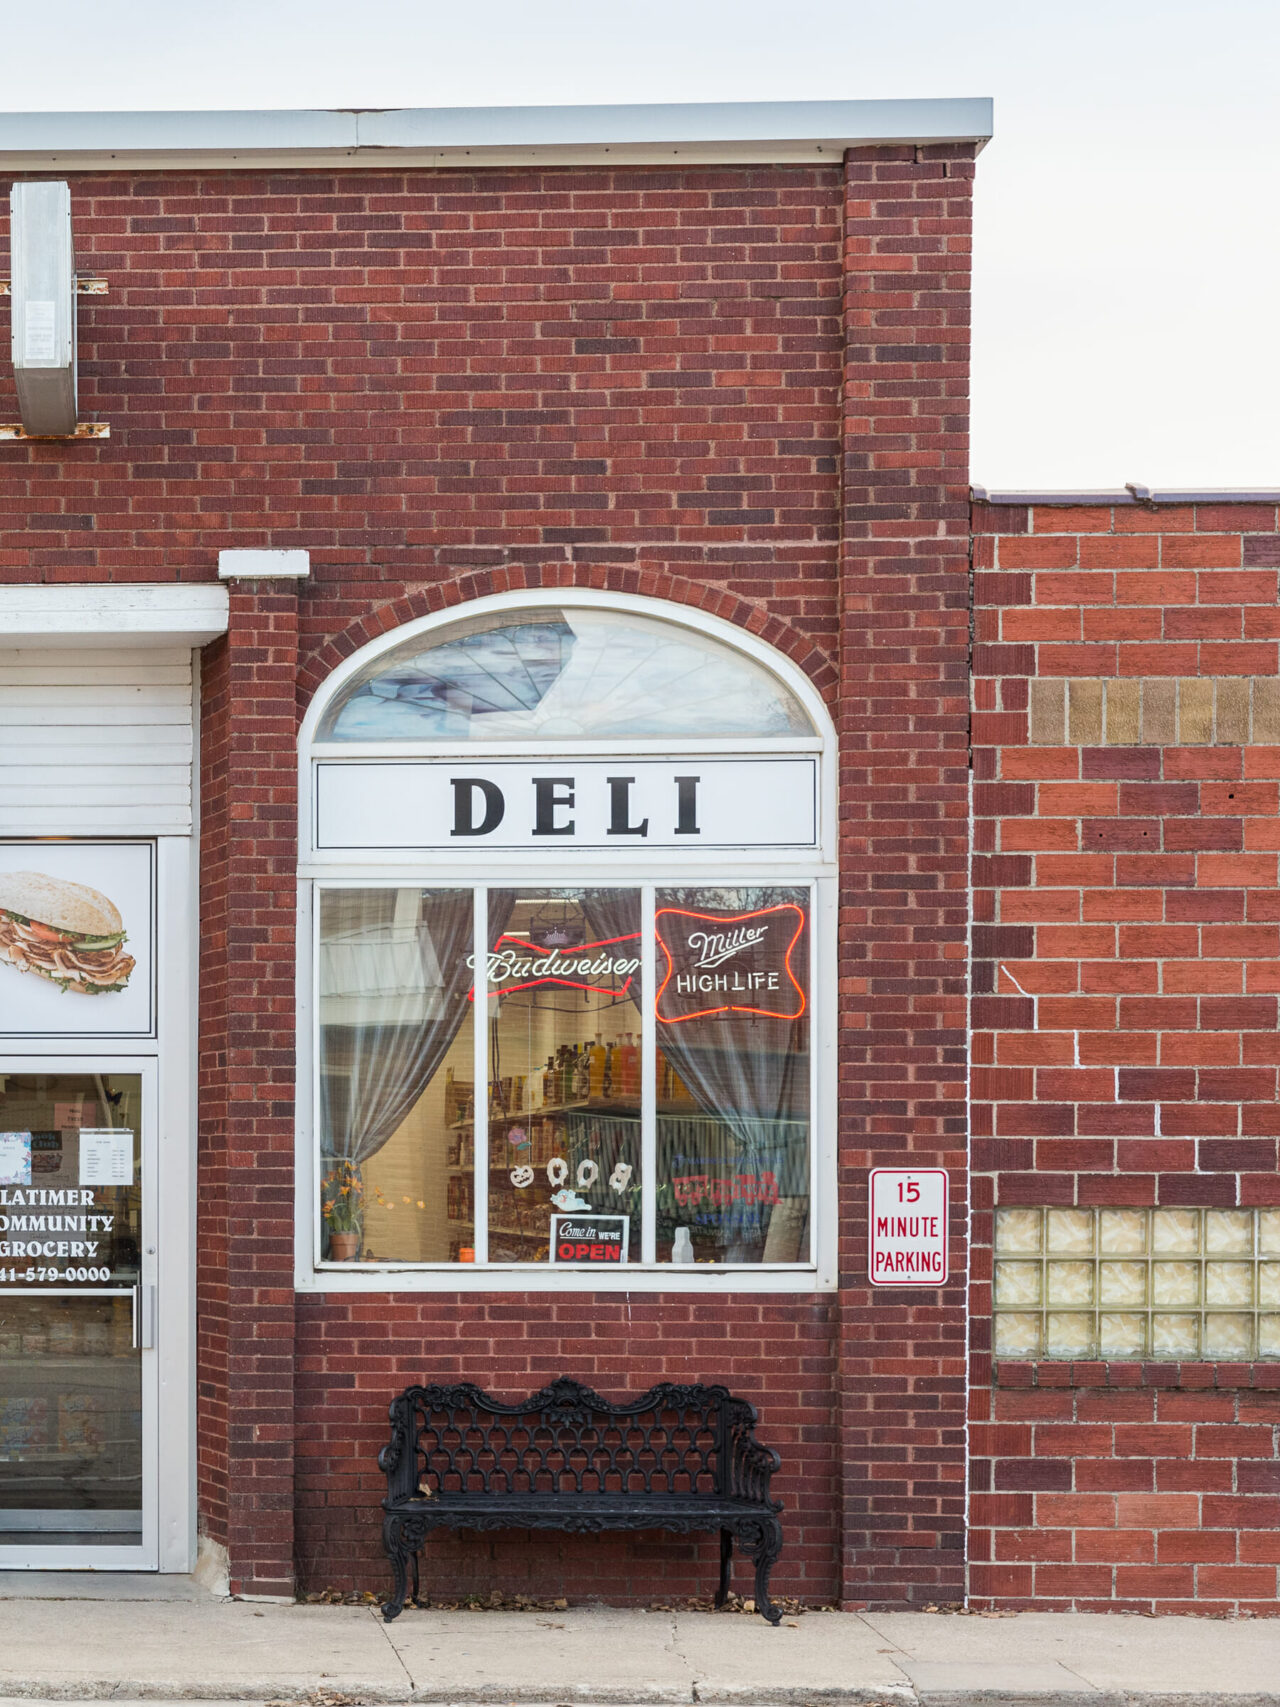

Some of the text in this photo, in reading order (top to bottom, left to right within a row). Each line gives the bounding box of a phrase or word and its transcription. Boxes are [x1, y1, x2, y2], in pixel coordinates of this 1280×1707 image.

[450, 776, 701, 837] DELI
[688, 926, 768, 964] Miller
[466, 949, 642, 982] Budweiser
[677, 971, 780, 994] HIGH LIFE
[0, 1189, 95, 1206] LATIMER
[897, 1182, 920, 1203] 15
[559, 1221, 621, 1240] Come in WE'RE
[877, 1217, 939, 1237] MINUTE
[558, 1243, 621, 1260] OPEN
[875, 1251, 942, 1273] PARKING
